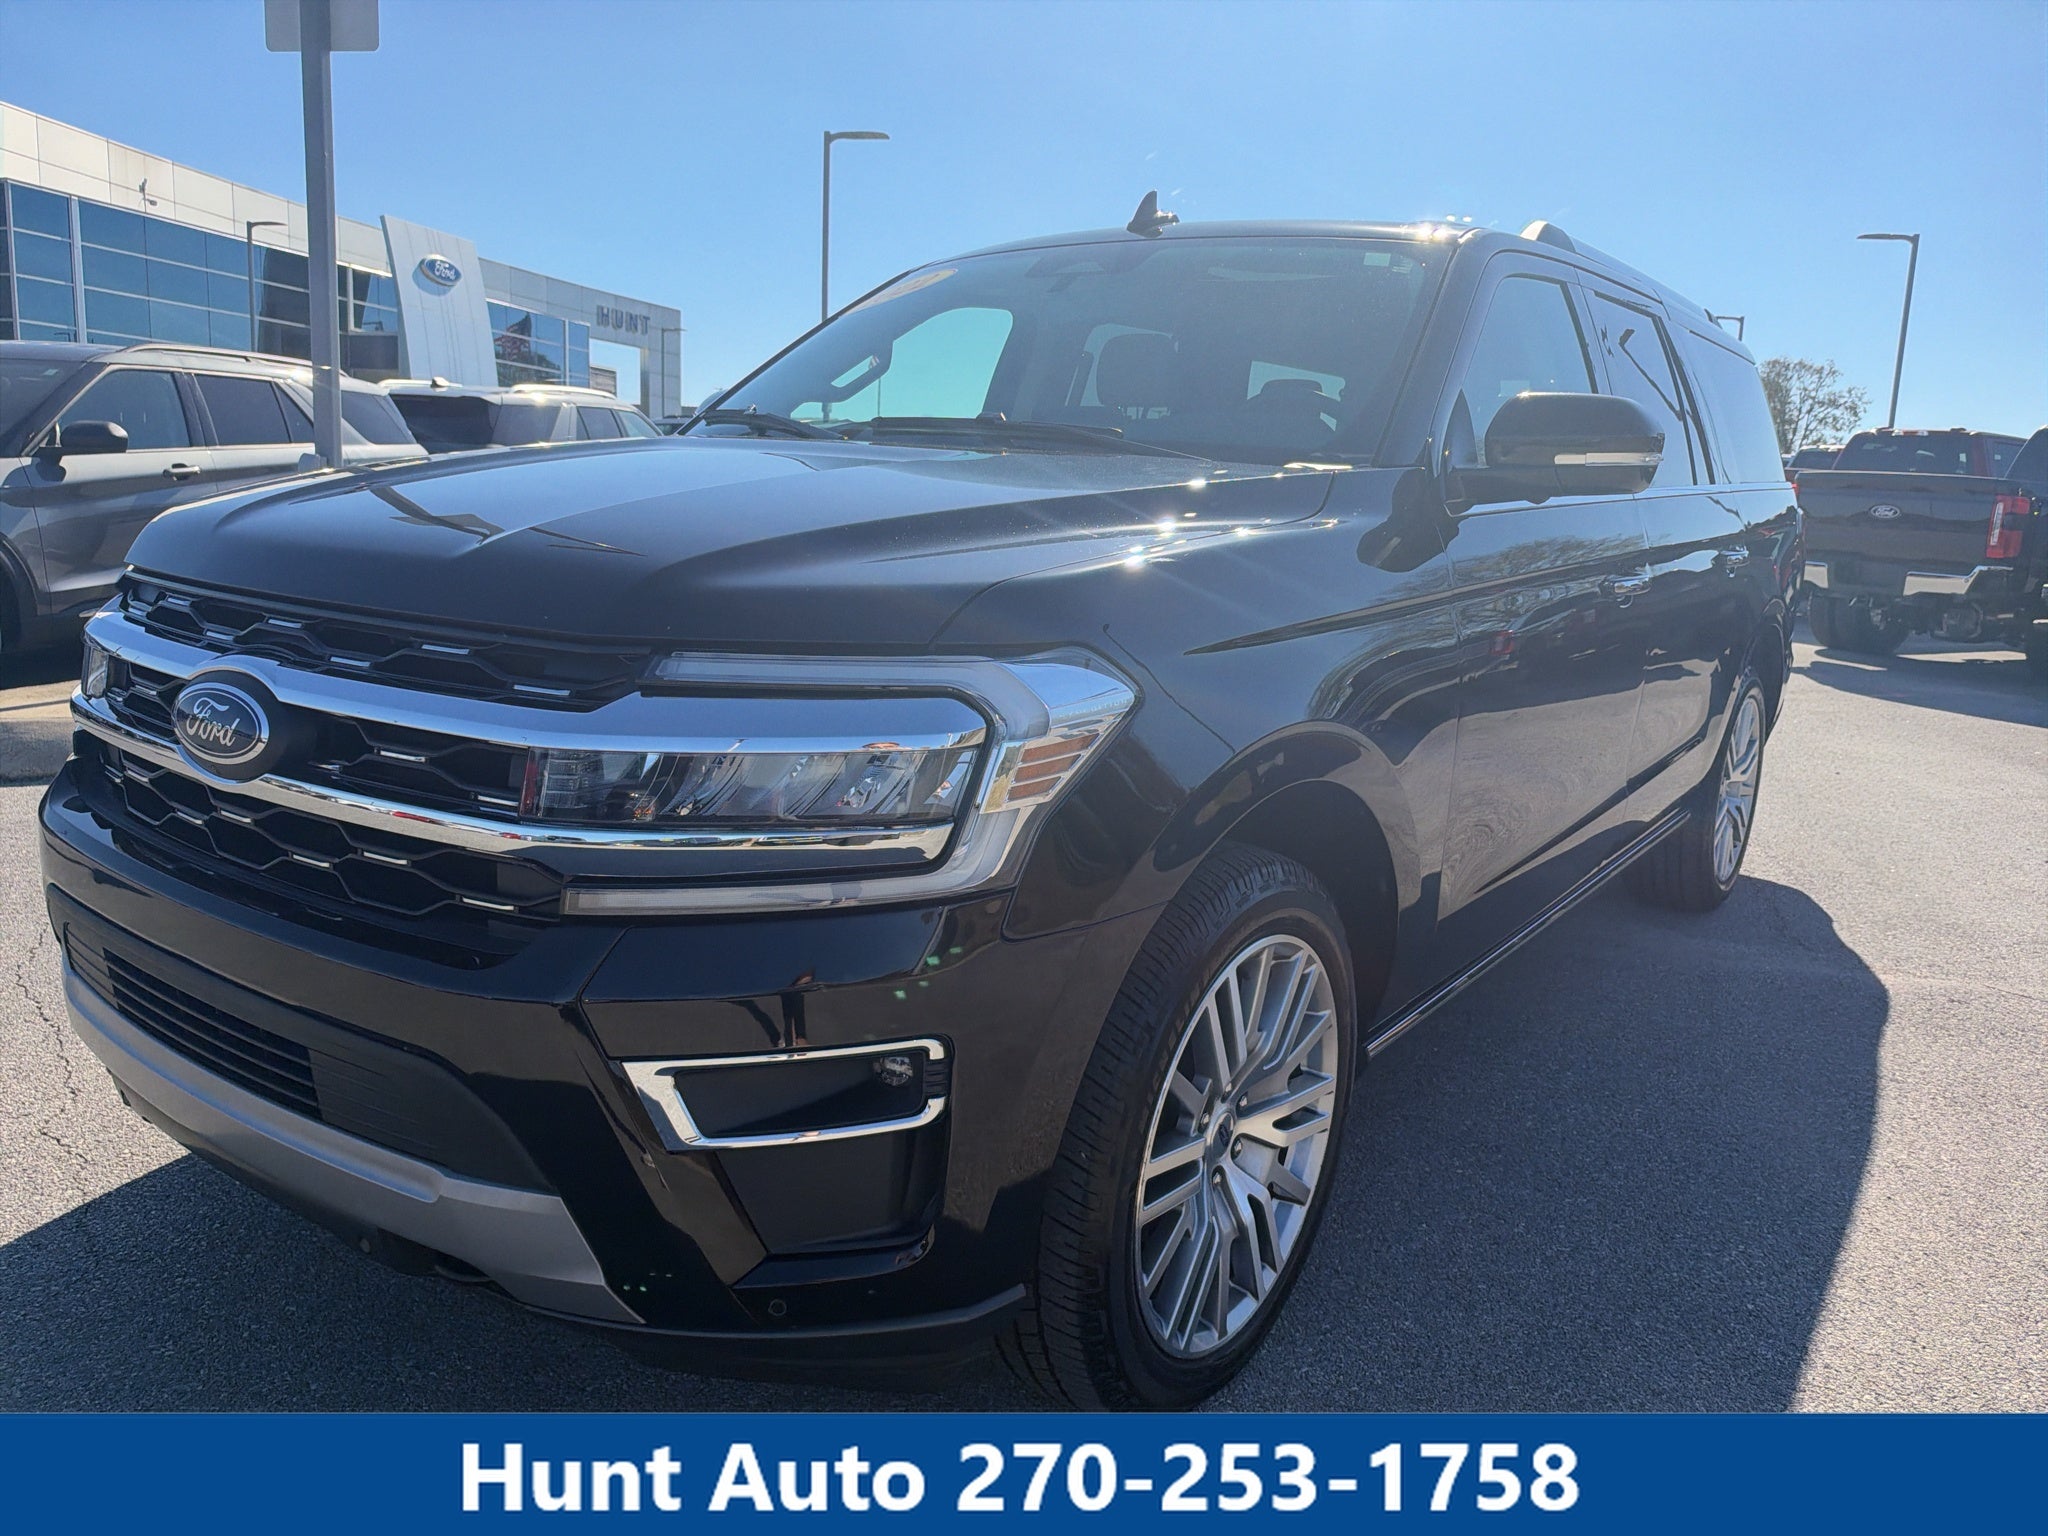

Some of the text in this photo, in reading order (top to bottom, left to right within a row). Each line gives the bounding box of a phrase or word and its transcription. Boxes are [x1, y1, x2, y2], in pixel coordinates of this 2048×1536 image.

[434, 259, 457, 281] Ford
[597, 304, 651, 336] HUNT
[186, 697, 240, 747] Ford
